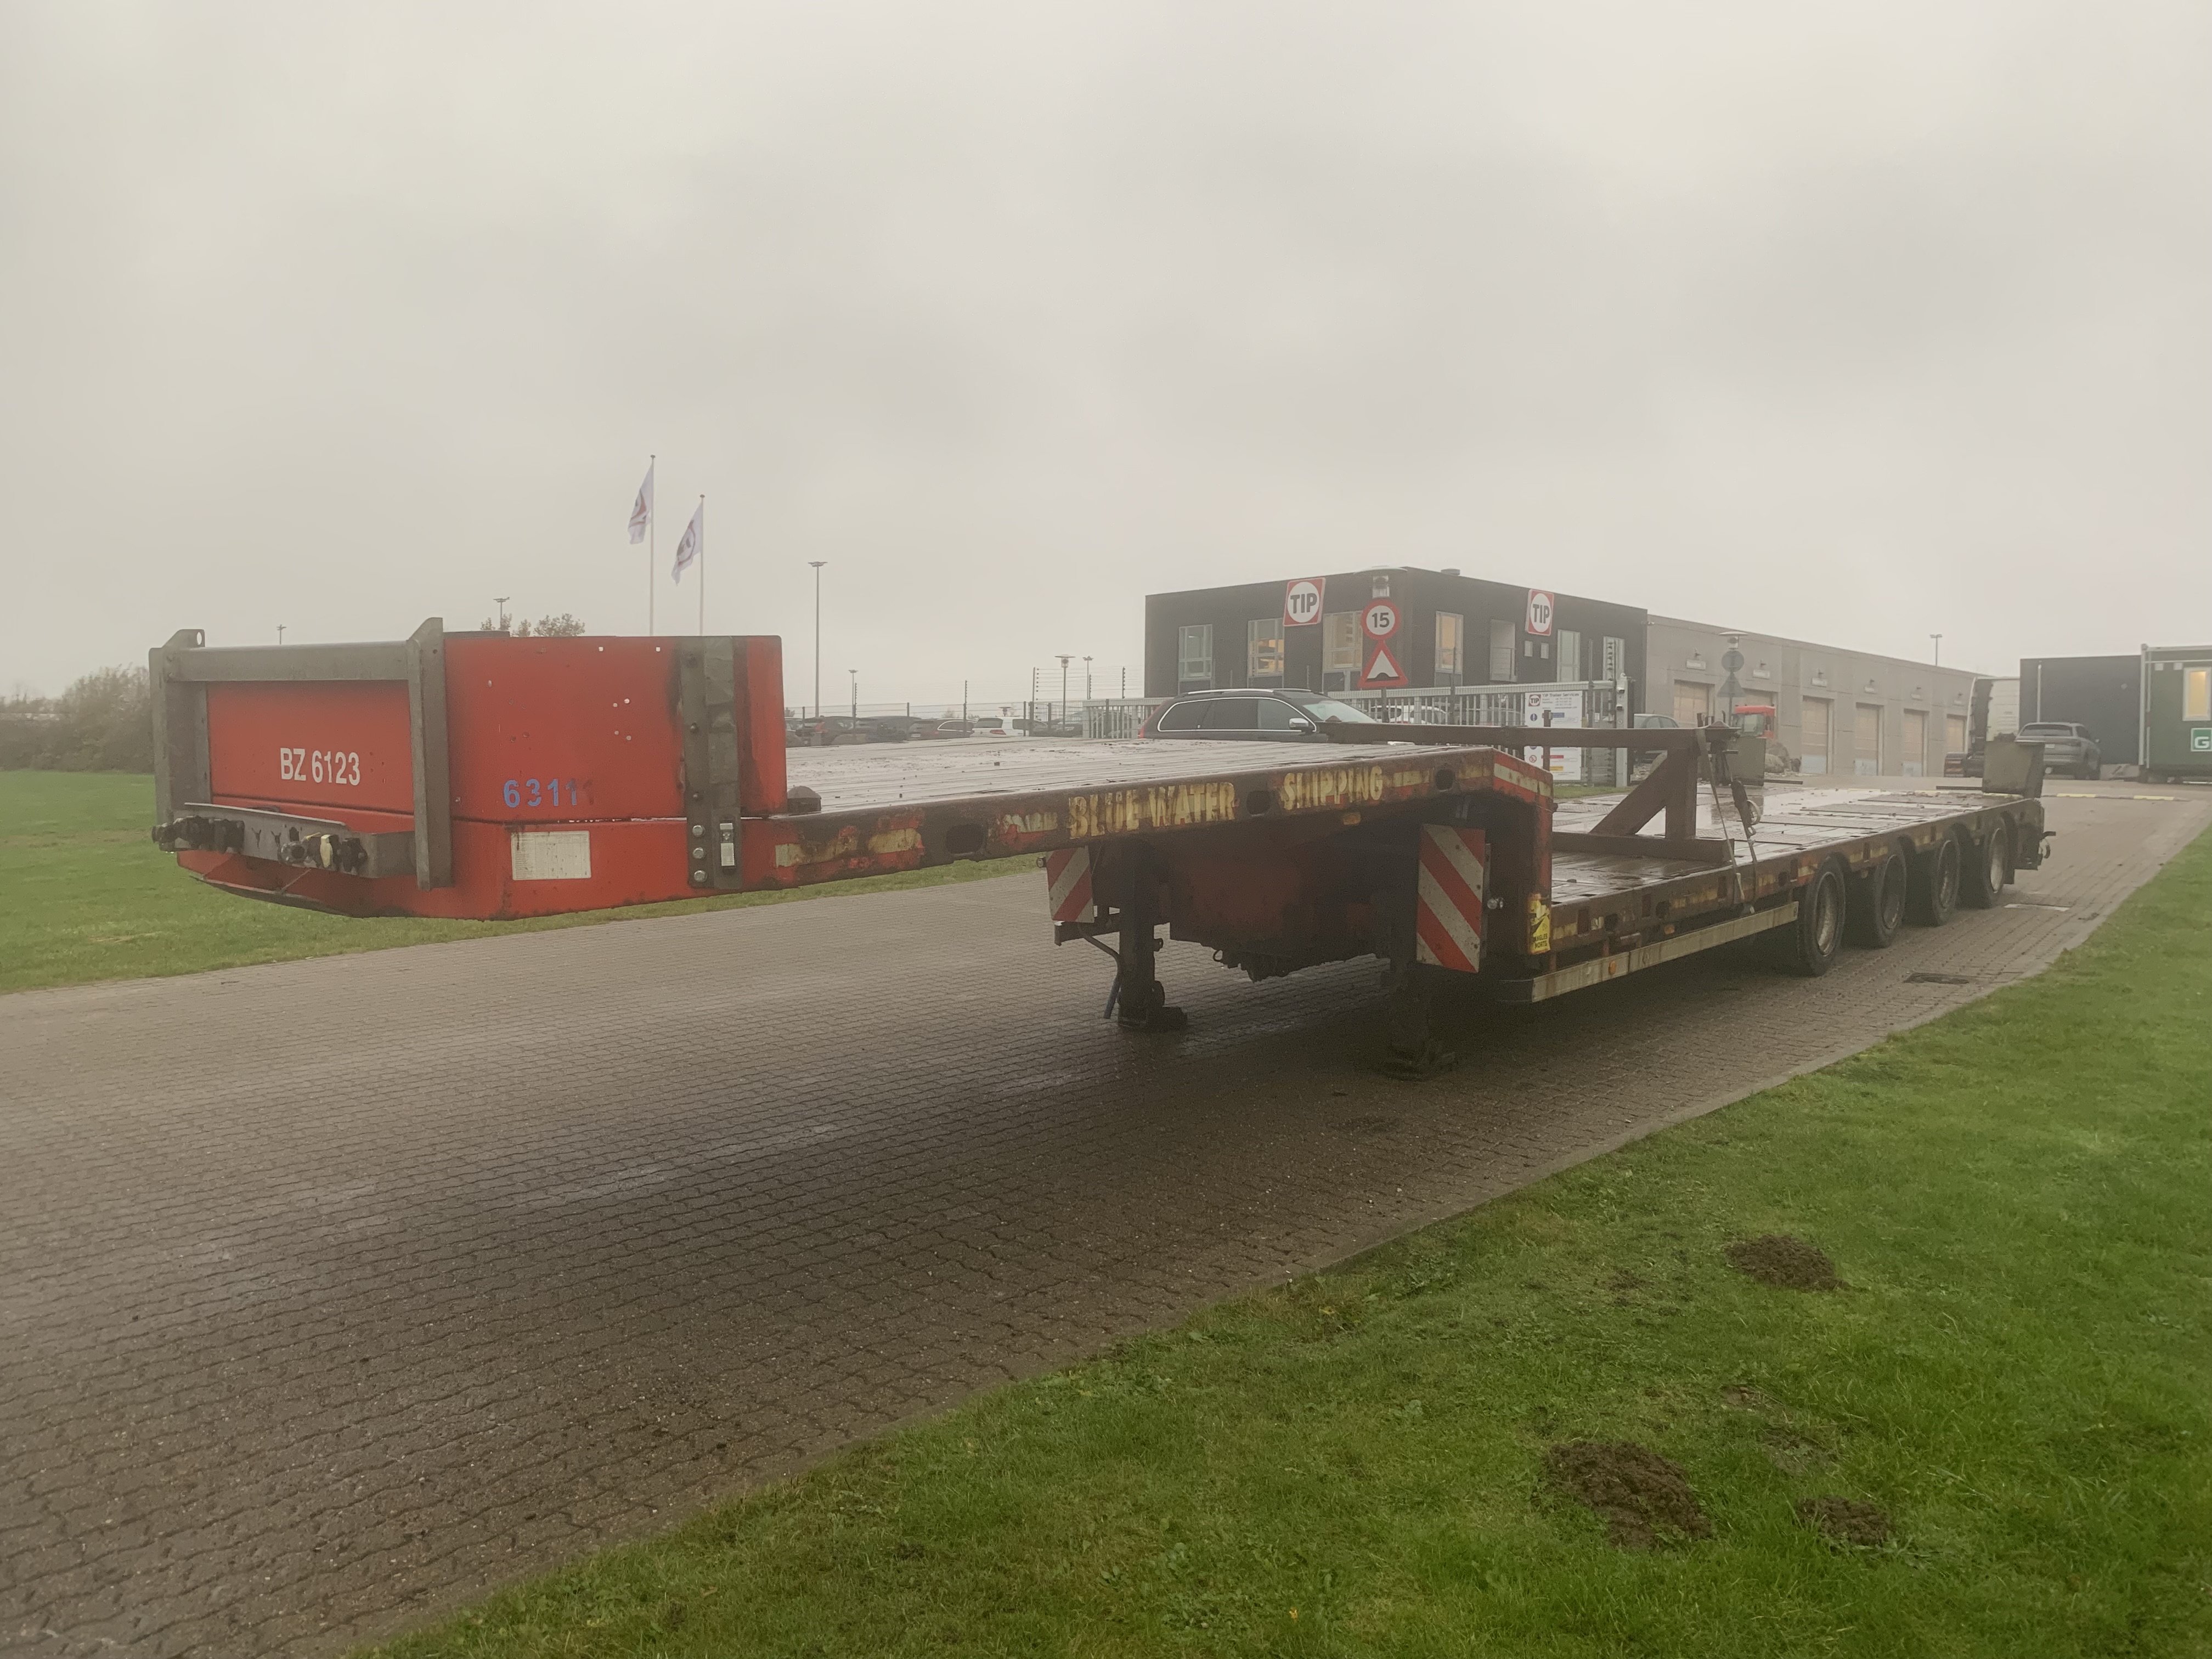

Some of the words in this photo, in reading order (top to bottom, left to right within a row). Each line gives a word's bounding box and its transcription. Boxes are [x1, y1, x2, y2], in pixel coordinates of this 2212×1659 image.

[1290, 593, 1317, 614] TIP
[1533, 604, 1550, 624] TIP
[1372, 612, 1390, 628] 15
[280, 748, 306, 781] BZ
[312, 750, 360, 786] 6123
[1283, 766, 1383, 810] SHIPPING
[1069, 789, 1139, 839] BLUE
[1148, 782, 1235, 827] WATER
